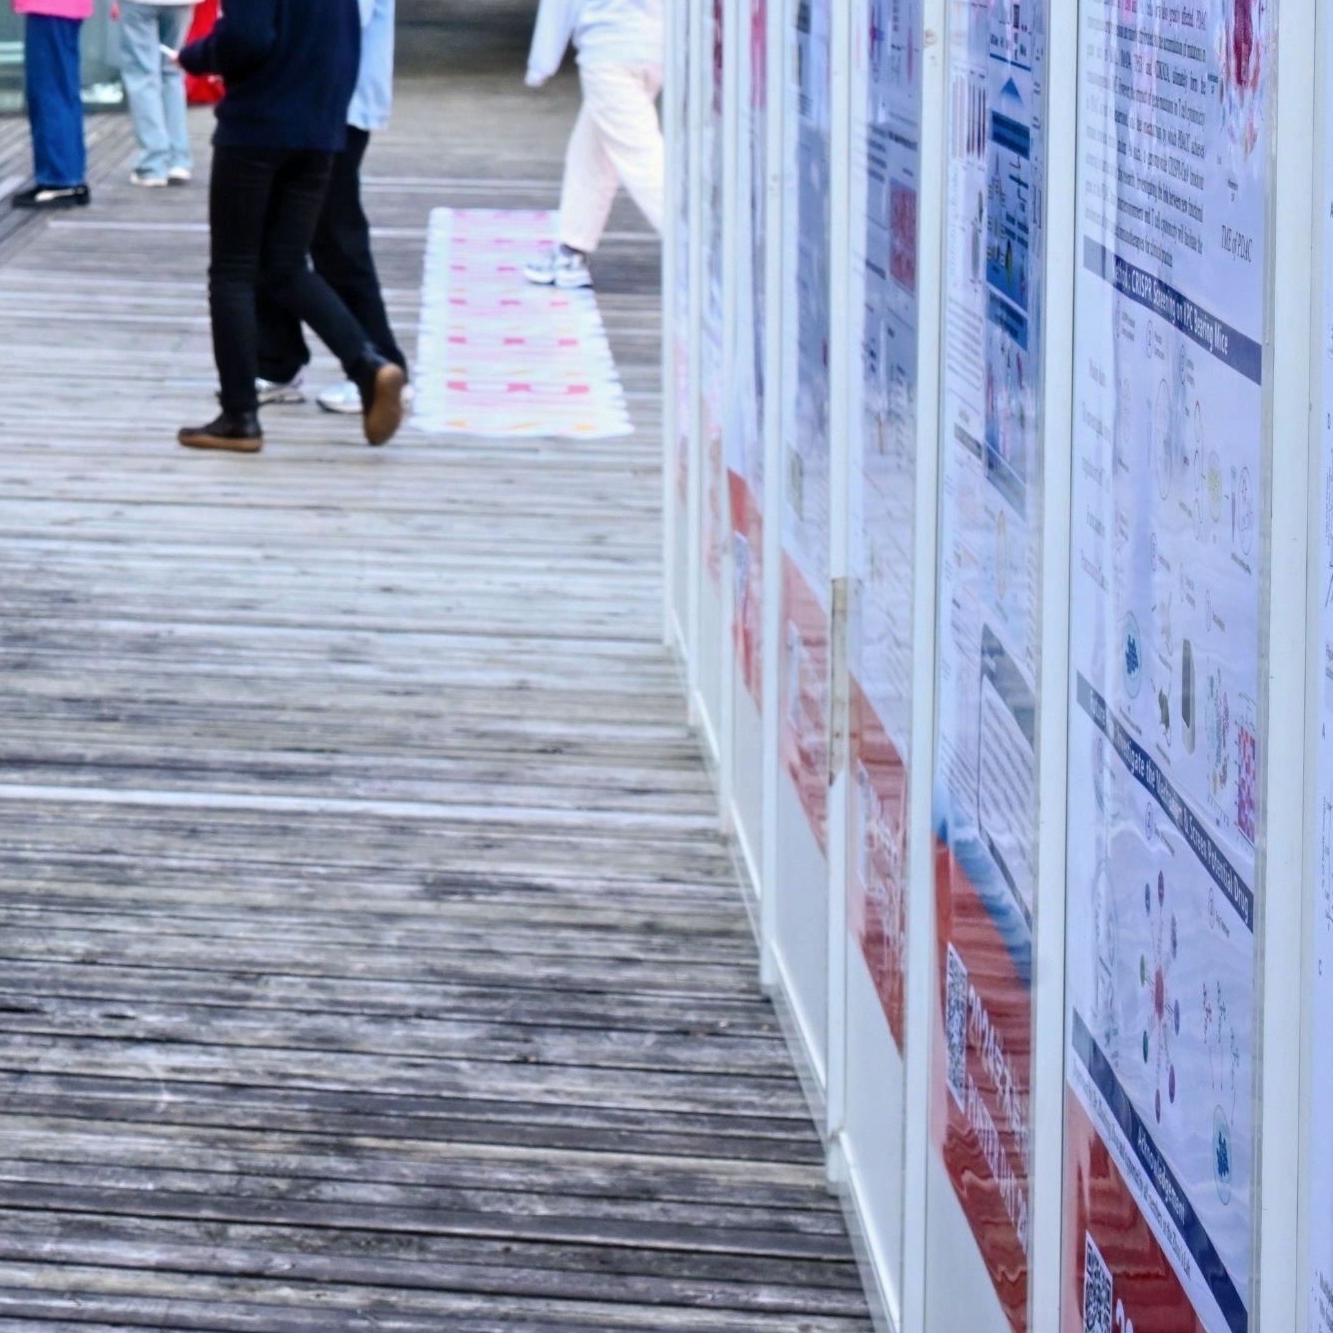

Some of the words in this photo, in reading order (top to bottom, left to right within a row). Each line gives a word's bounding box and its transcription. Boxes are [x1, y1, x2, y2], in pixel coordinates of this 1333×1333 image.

[1131, 267, 1152, 304] CRISPR
[1194, 307, 1213, 354] Bearing
[1214, 320, 1228, 356] Mice
[1207, 838, 1232, 895] Potential
[1234, 873, 1248, 927] Drug
[1137, 1120, 1185, 1230] Acknowledgement
